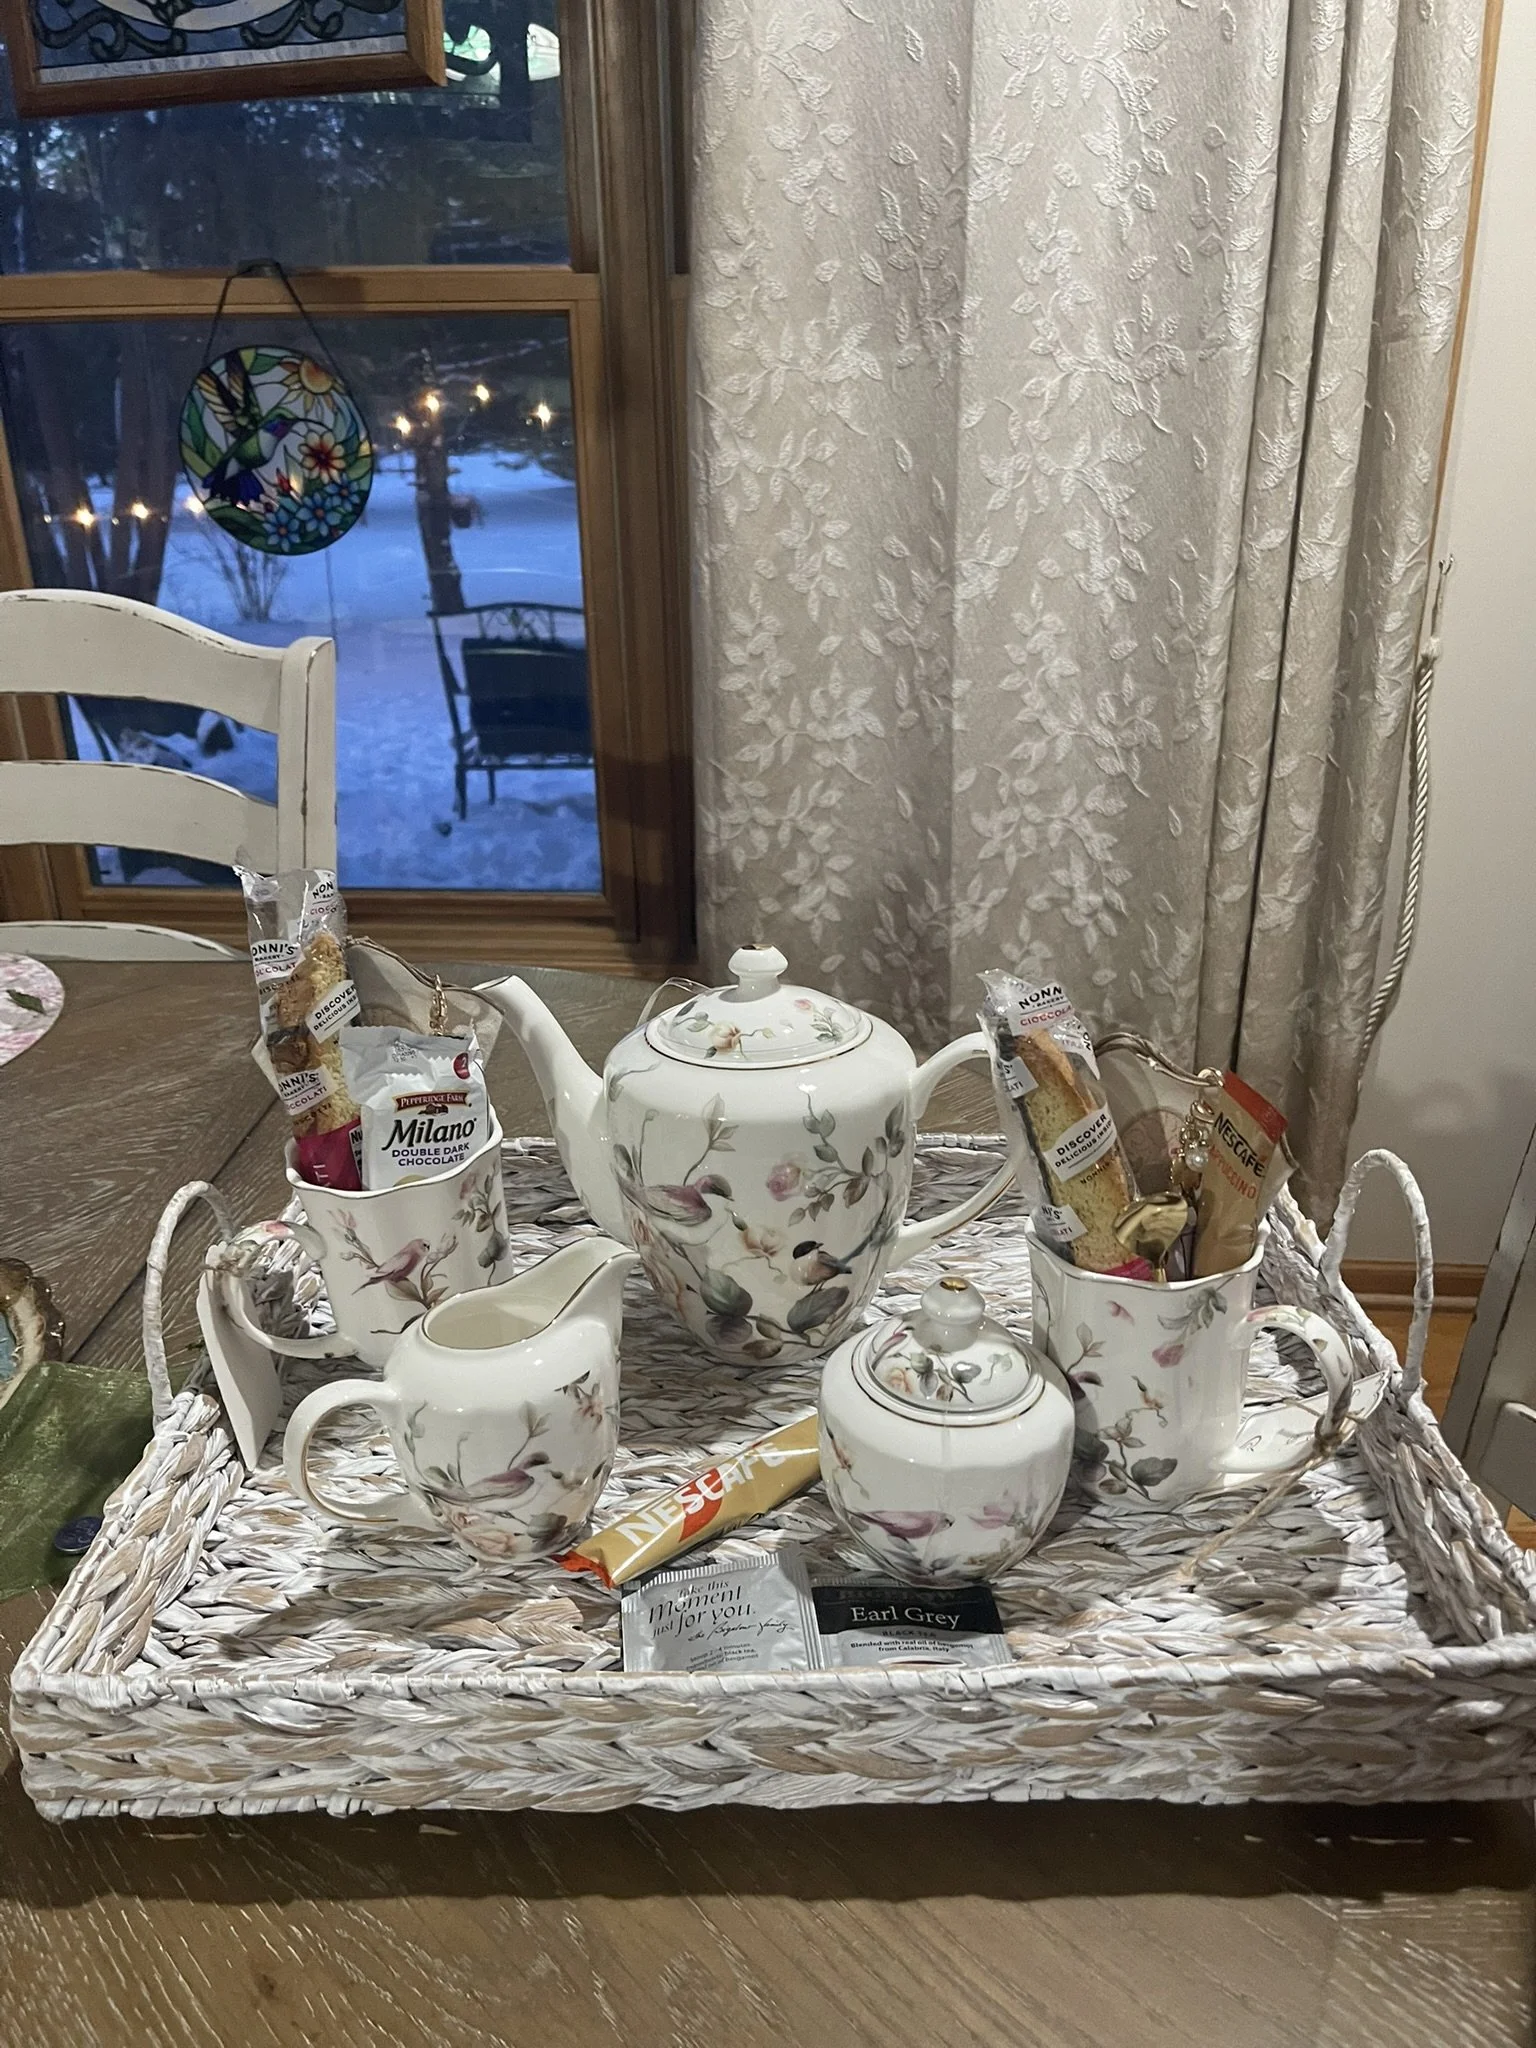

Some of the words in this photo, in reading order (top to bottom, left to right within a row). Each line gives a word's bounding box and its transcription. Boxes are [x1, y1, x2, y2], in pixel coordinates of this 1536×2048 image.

[381, 1118, 475, 1151] Milano
[1056, 1113, 1107, 1156] DISCOVER
[392, 1148, 441, 1157] DOUBLE
[443, 1142, 470, 1155] DARK
[398, 1153, 465, 1167] CHOCOLATE
[1055, 1138, 1097, 1168] DELICIOUS
[707, 1581, 729, 1591] this
[653, 1620, 674, 1639] just
[675, 1609, 707, 1638] for
[850, 1605, 899, 1622] Earl
[904, 1607, 961, 1630] Grey
